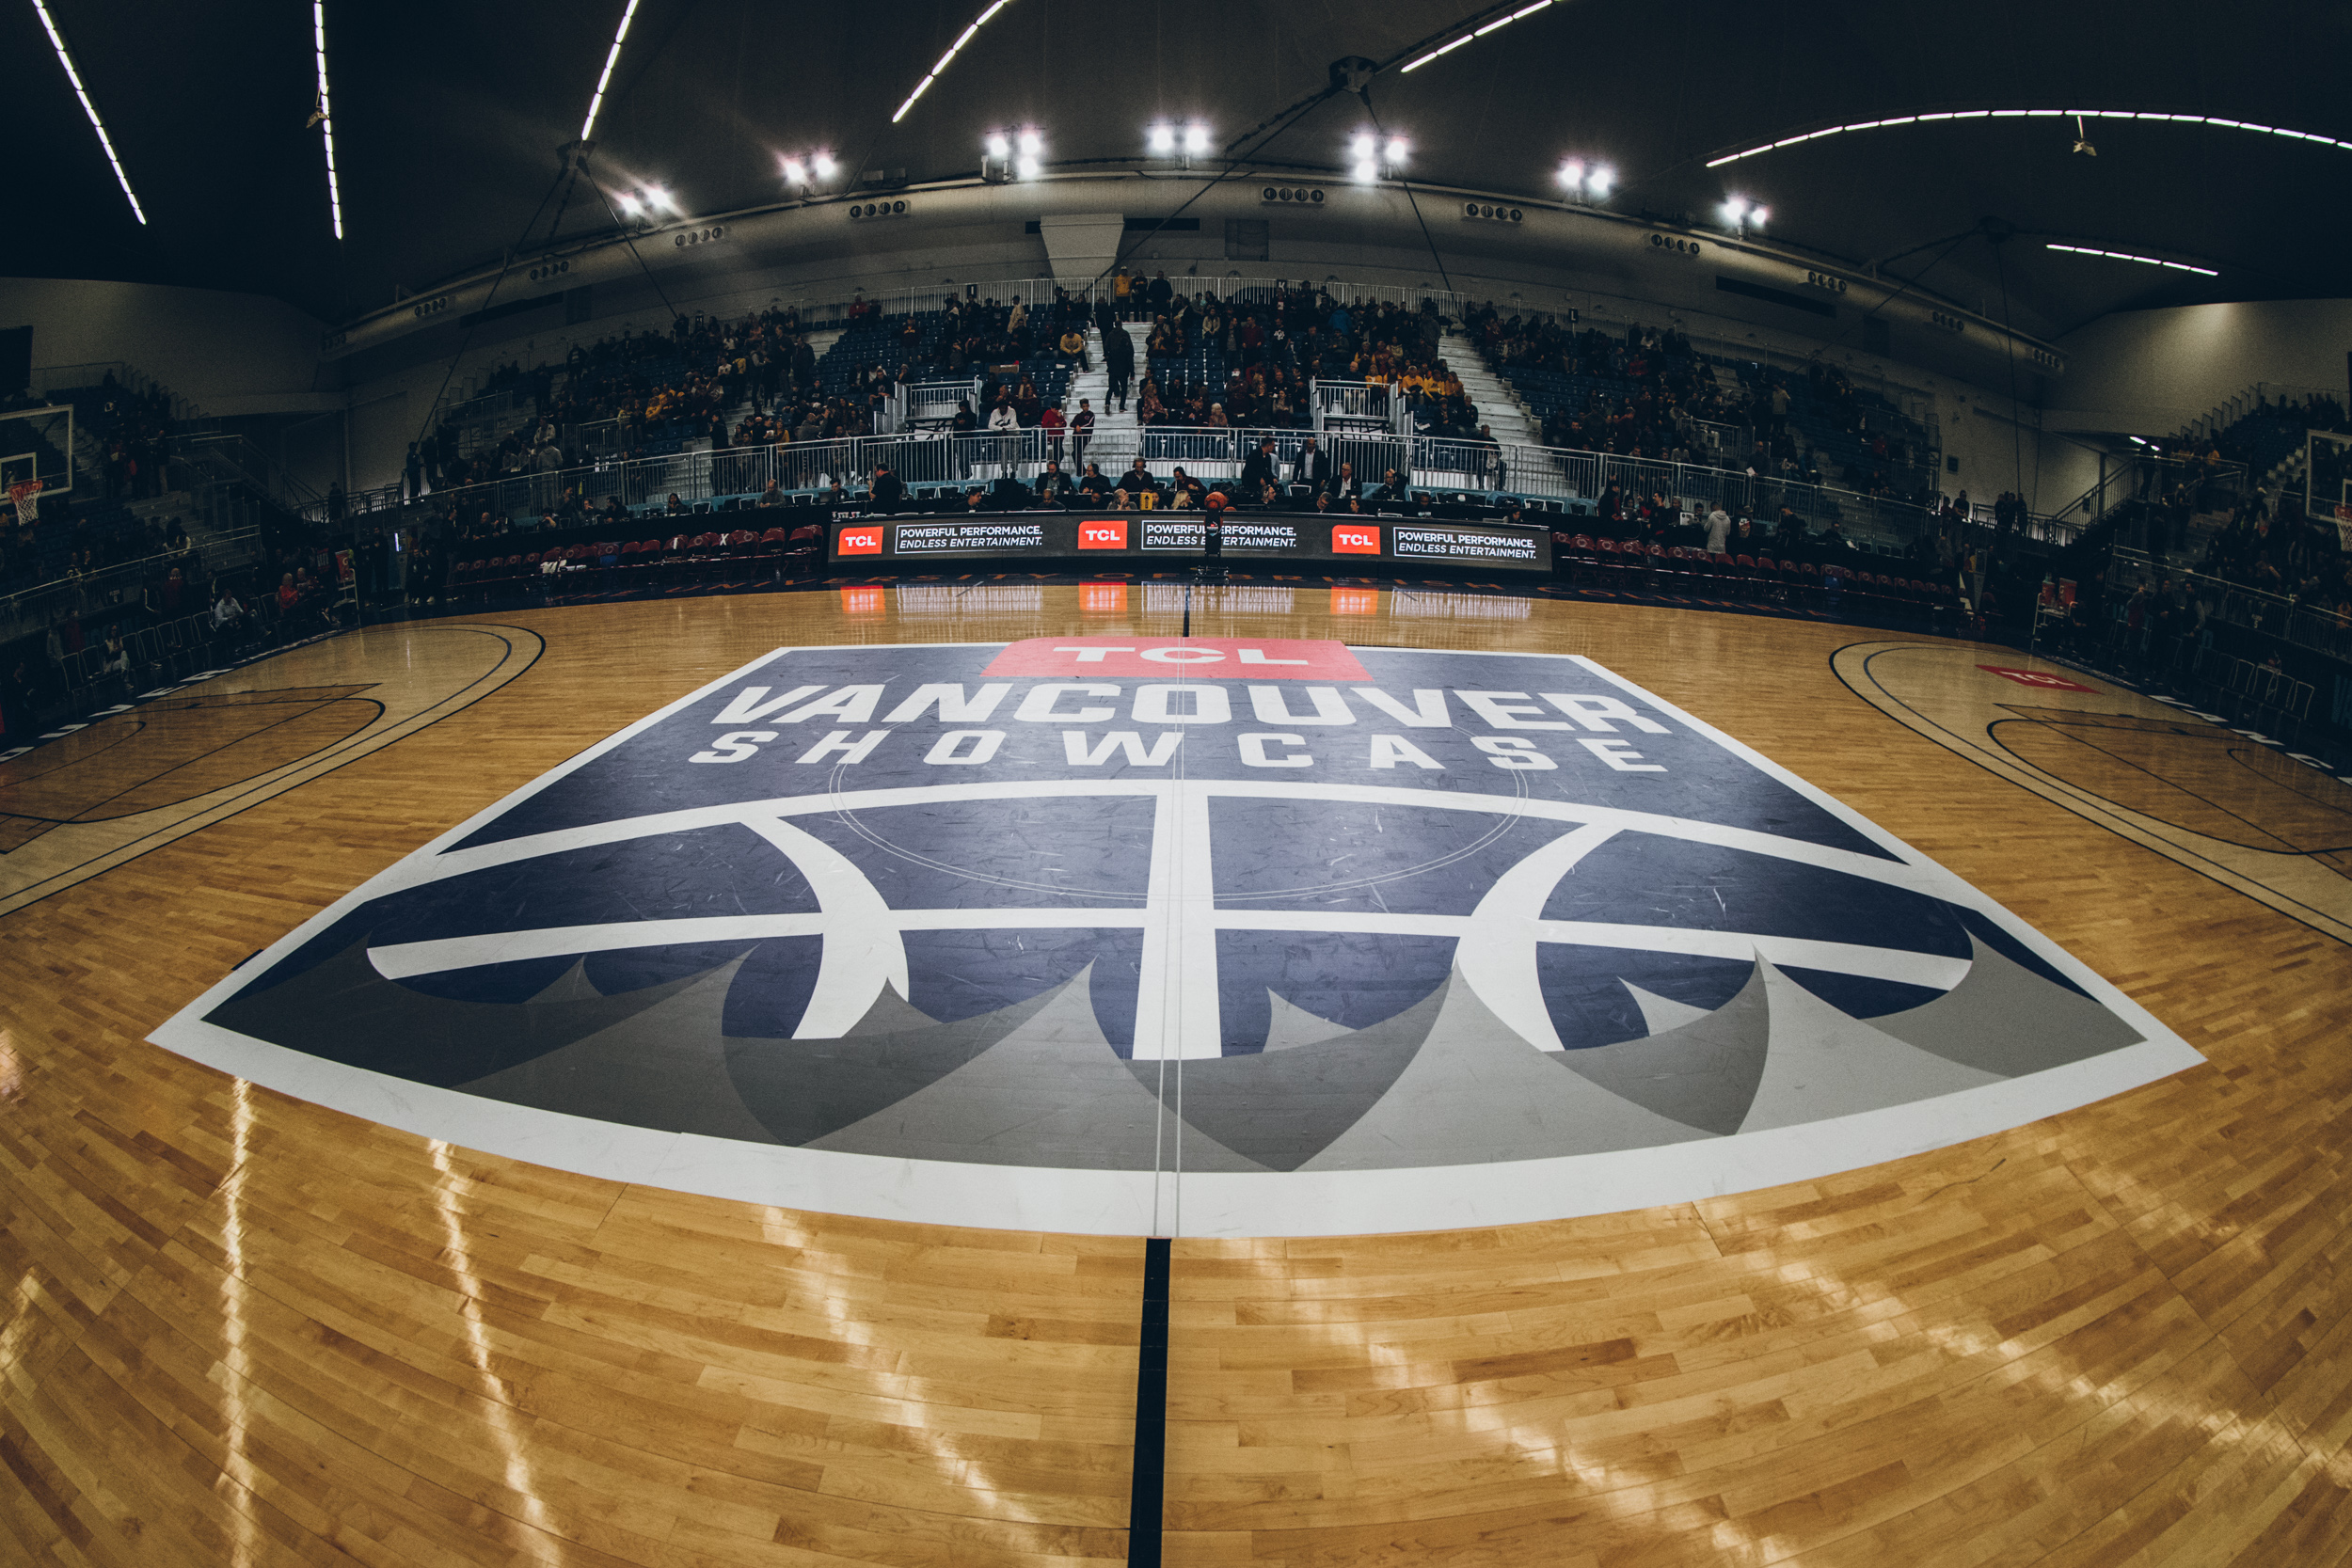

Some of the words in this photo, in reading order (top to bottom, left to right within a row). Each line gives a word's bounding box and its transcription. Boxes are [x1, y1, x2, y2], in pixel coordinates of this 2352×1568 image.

[1570, 309, 1577, 322] L
[900, 529, 958, 538] POWERFUL
[960, 525, 1043, 536] PERFORMANCE.
[1084, 530, 1120, 541] TCL
[845, 536, 876, 547] TCL
[899, 539, 947, 549] ENDLESS
[949, 536, 1043, 547] ENTERTAINMENT.
[1146, 535, 1198, 545] ENDLESS
[1200, 536, 1297, 547] EERTAINMENT.
[1339, 534, 1374, 546] TCL
[1398, 531, 1456, 544] POWERFUL
[1458, 534, 1536, 548] PERFORMANCE.
[1399, 543, 1447, 553] ENDLESS
[1449, 545, 1537, 560] ENTERTAINMENT.
[664, 572, 1061, 594] UNIVERSITY
[1226, 573, 1506, 592] BRITISH
[1052, 645, 1310, 666] TCL
[1999, 671, 2076, 687] TCL
[709, 683, 1673, 734] VANCOUVER
[688, 730, 1669, 772] SHOWCASE
